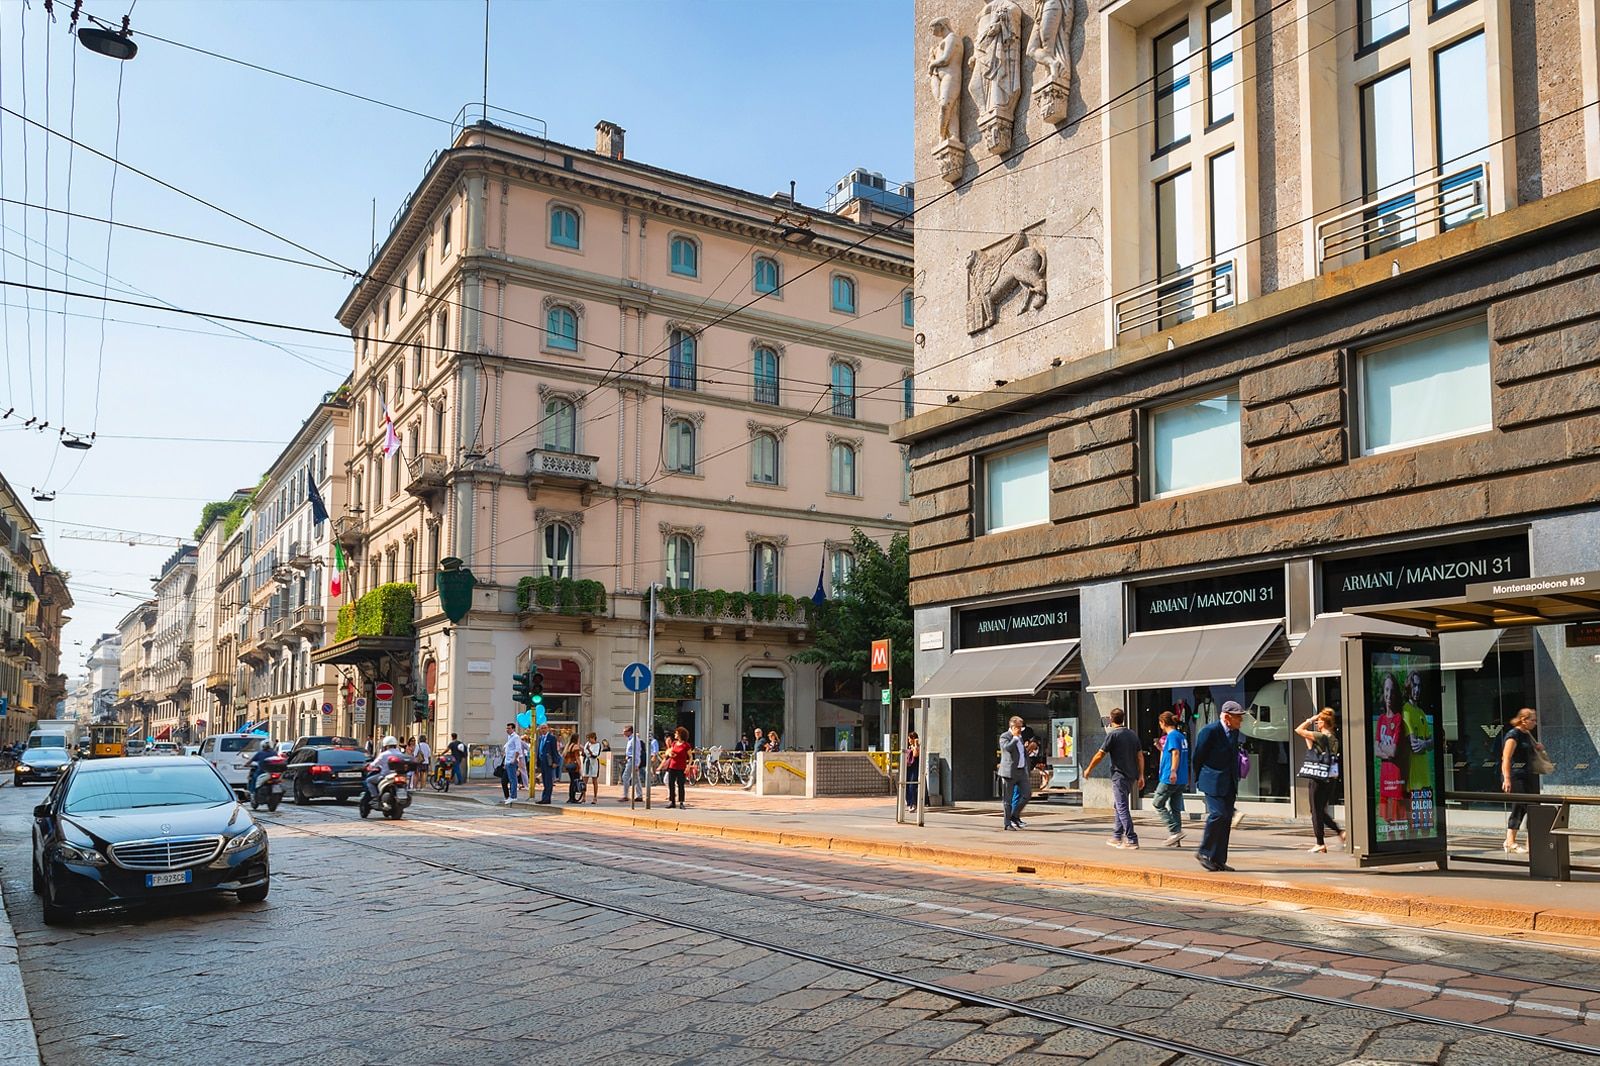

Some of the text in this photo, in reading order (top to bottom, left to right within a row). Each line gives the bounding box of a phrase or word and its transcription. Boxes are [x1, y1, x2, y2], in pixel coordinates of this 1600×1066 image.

[1342, 571, 1393, 592] ARMANI
[1406, 560, 1487, 584] MANZONI
[1492, 557, 1512, 574] 31
[1493, 576, 1585, 594] Montenapoleone M3
[1150, 597, 1188, 614] ARMANI
[1197, 588, 1256, 608] MANZONI
[1259, 587, 1274, 600] 31
[977, 619, 1006, 633] ARMANI
[1012, 613, 1055, 629] MANZONI
[1056, 611, 1068, 624] 31
[873, 648, 886, 665] M
[1411, 790, 1433, 799] MILANO
[1411, 800, 1433, 810] CALCIO
[1412, 811, 1433, 819] CITY
